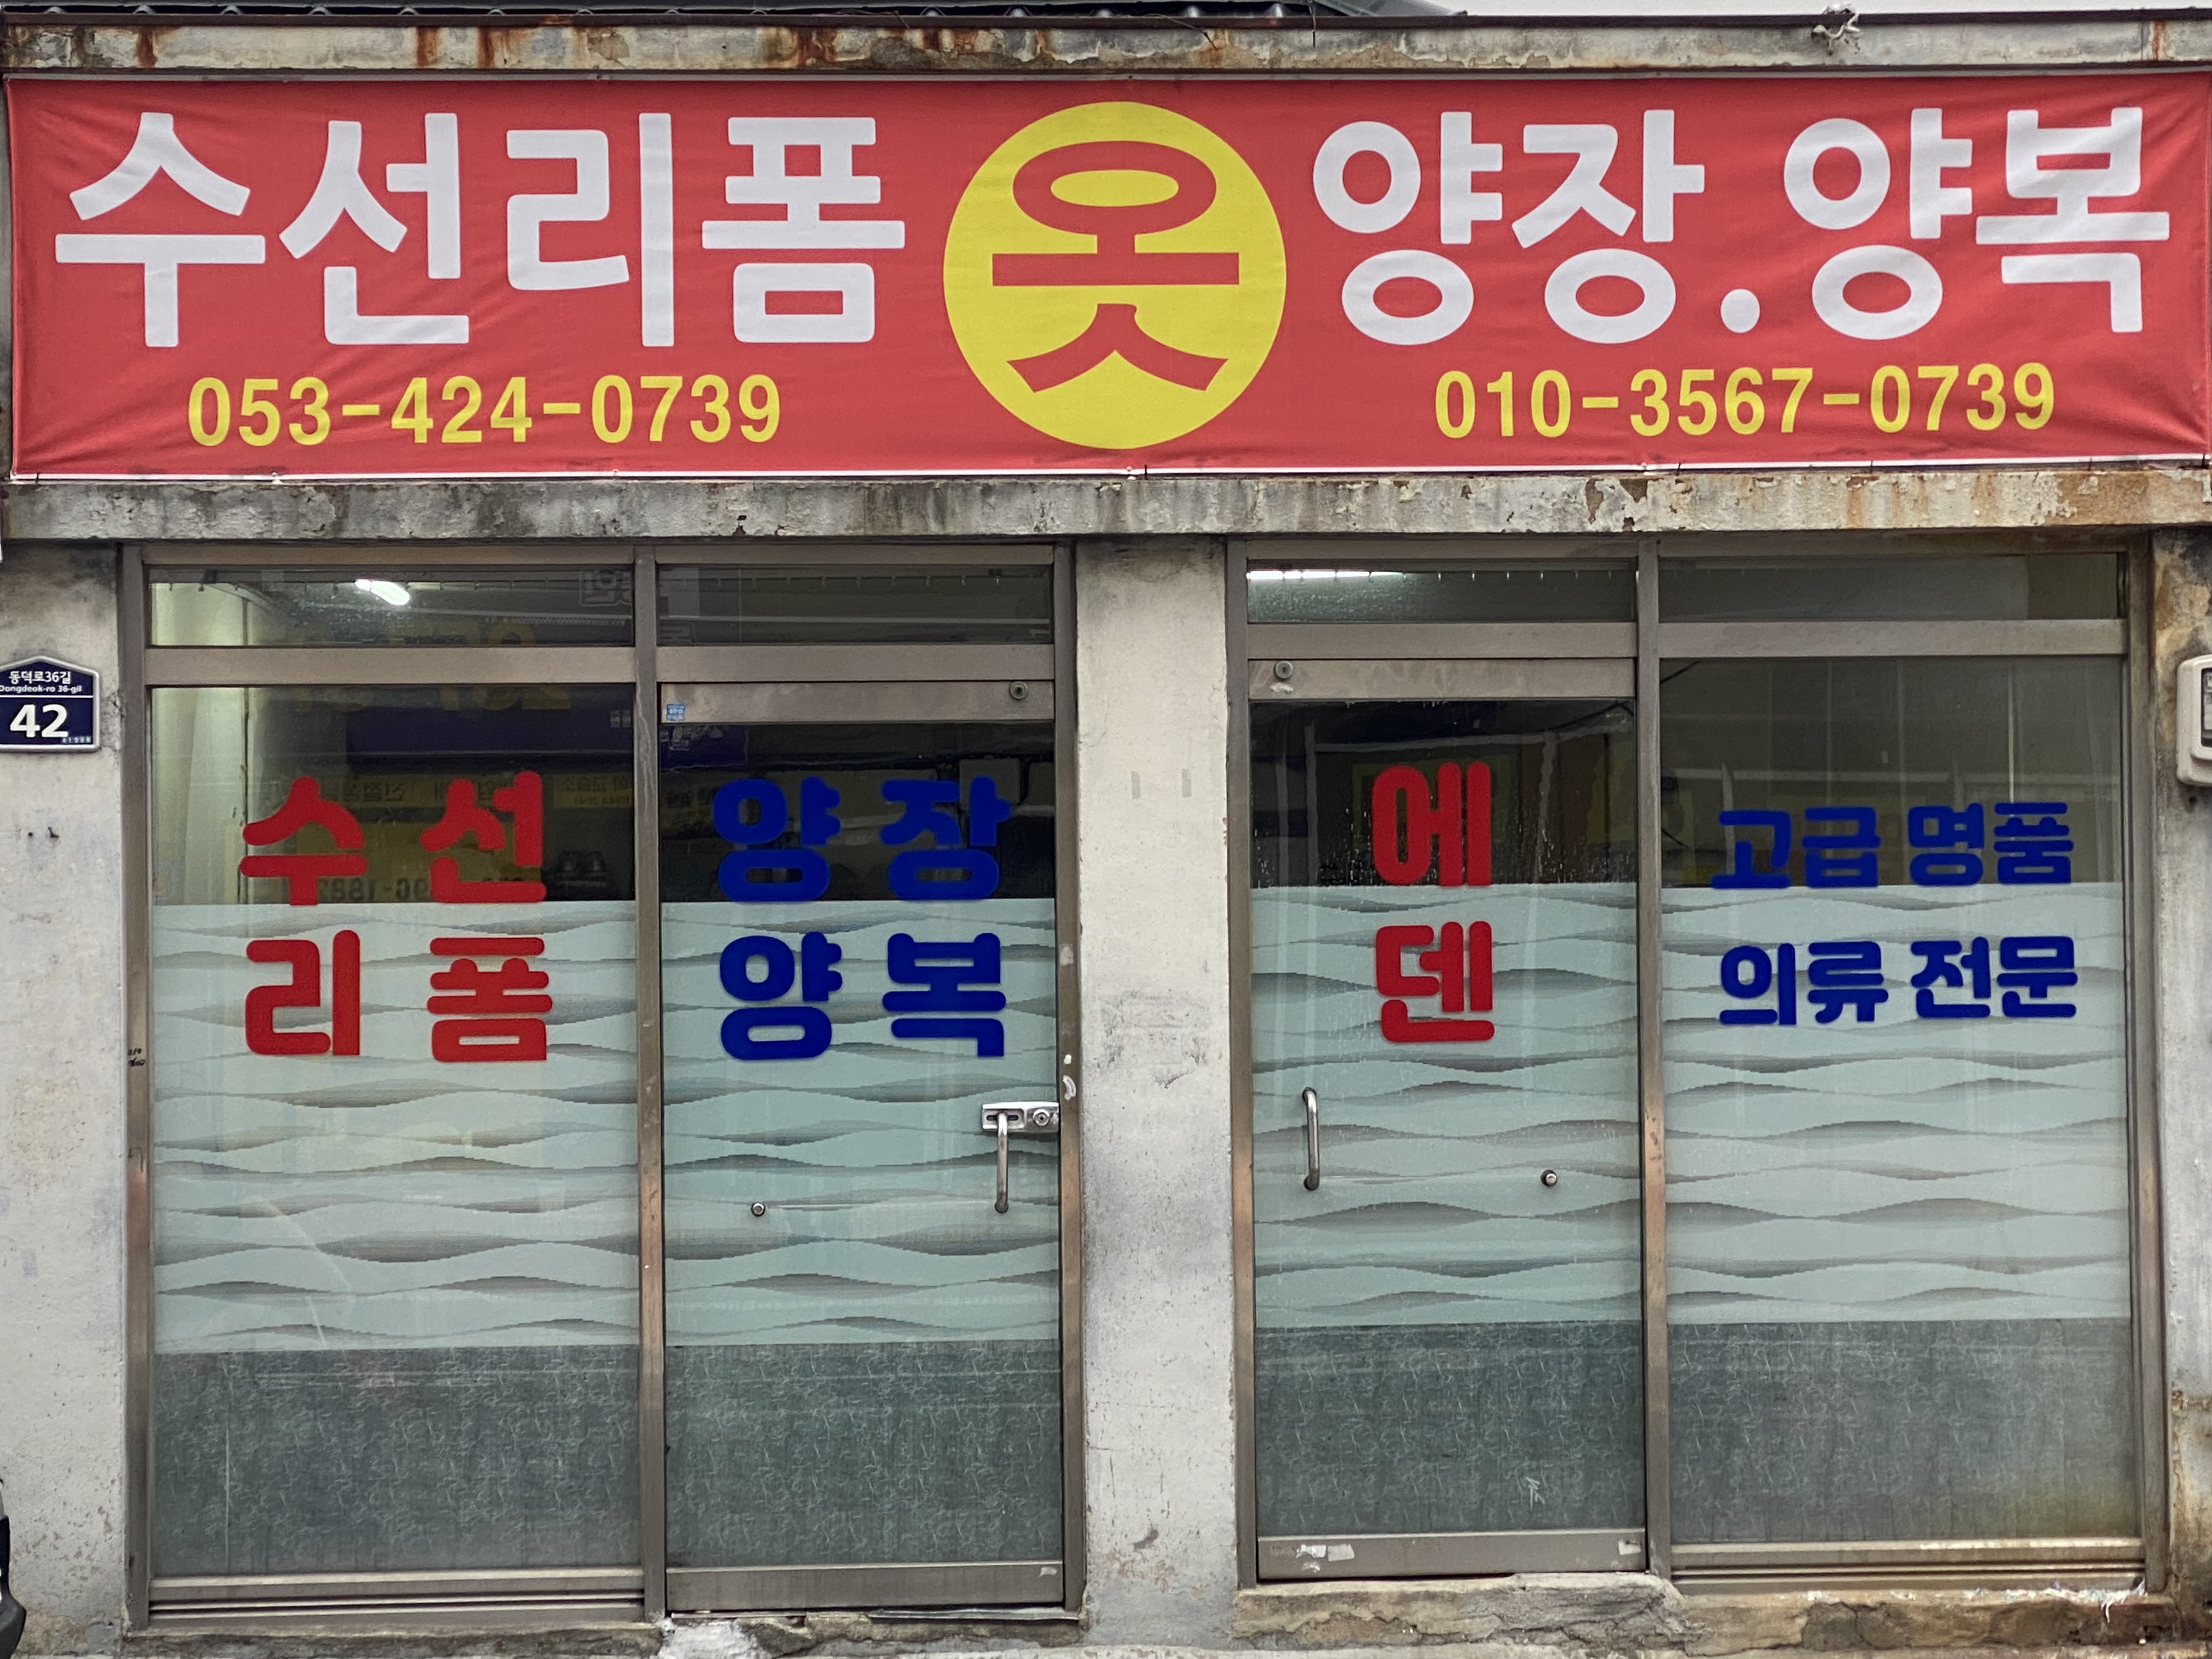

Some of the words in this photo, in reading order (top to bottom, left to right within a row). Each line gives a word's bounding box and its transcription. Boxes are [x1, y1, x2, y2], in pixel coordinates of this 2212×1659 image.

[992, 140, 1239, 393] 옷
[188, 374, 780, 447] 053-424-0739
[1435, 363, 2054, 439] 010-3567-0739
[0, 685, 55, 693] Dongdeok-ro
[58, 685, 82, 693] 36-gil
[9, 671, 71, 684] 동덕로36길
[10, 704, 69, 738] 42
